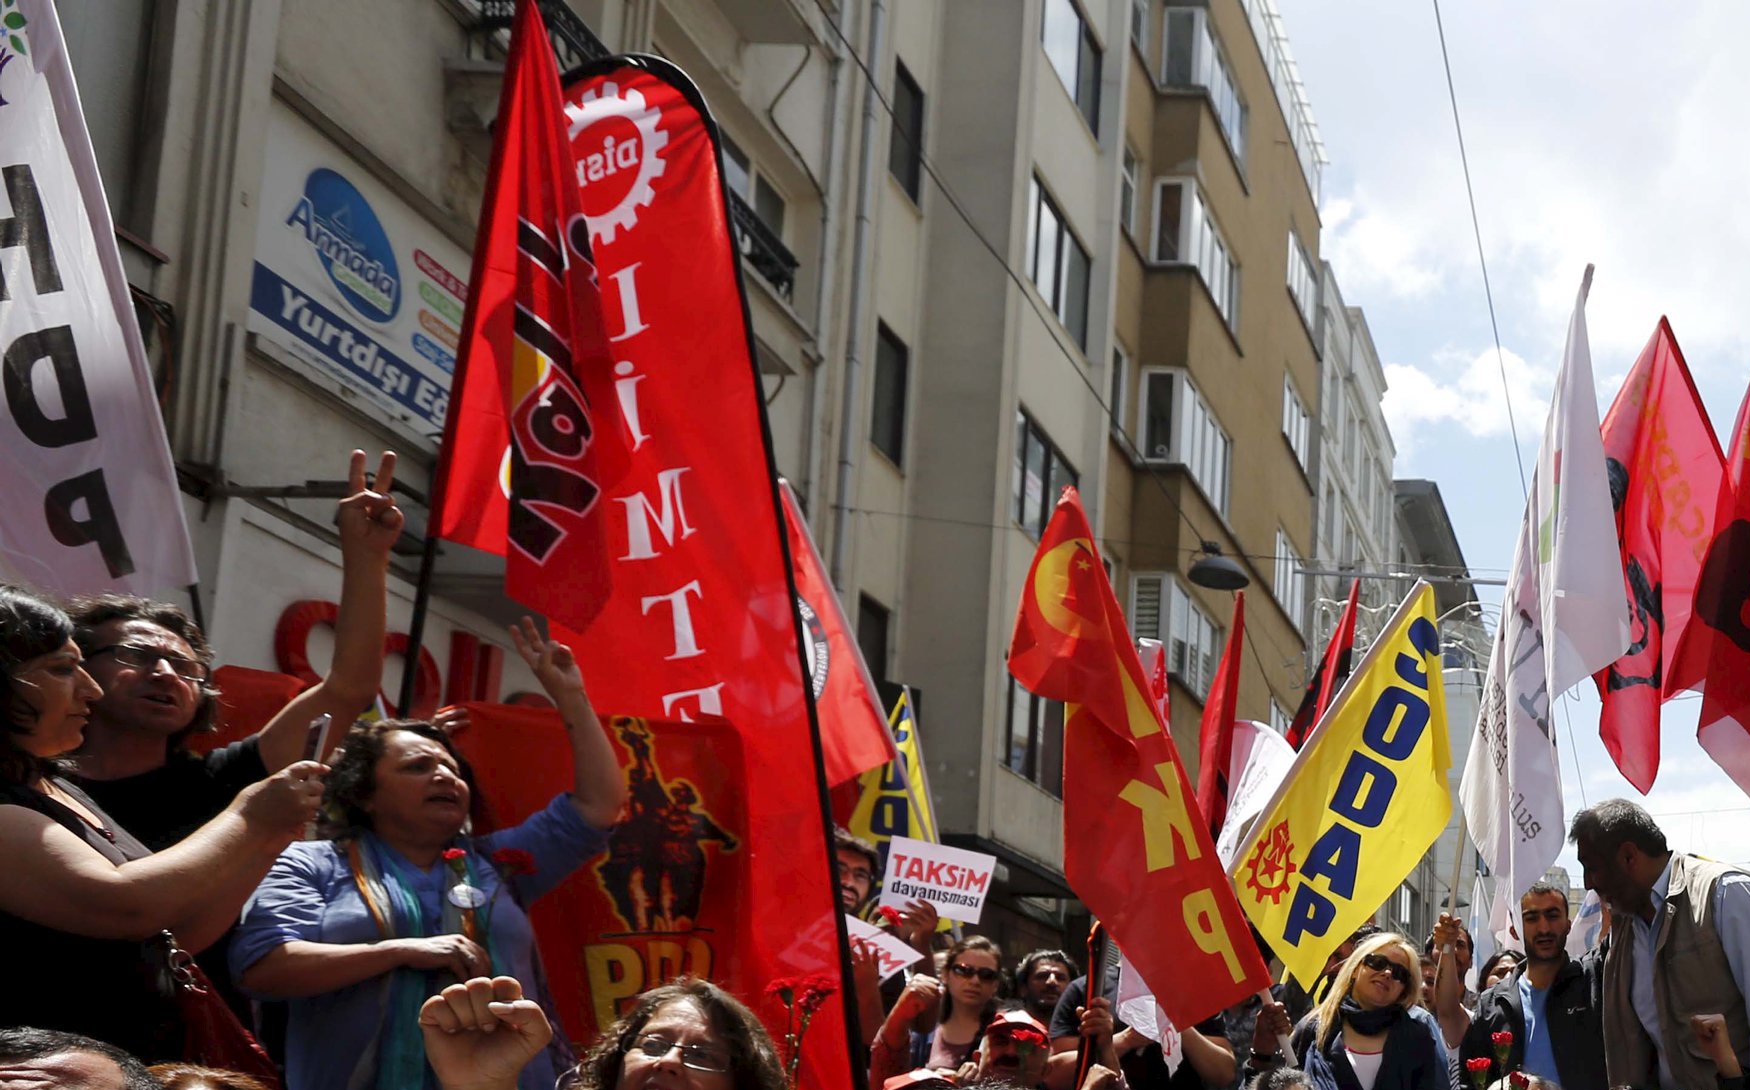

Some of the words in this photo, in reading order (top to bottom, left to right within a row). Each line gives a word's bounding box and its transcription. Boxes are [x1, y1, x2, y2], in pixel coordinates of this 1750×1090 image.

[285, 195, 396, 298] Armada
[281, 283, 410, 395] Yurtdışı
[1283, 617, 1439, 946] SODAP
[891, 880, 980, 908] dayanışması
